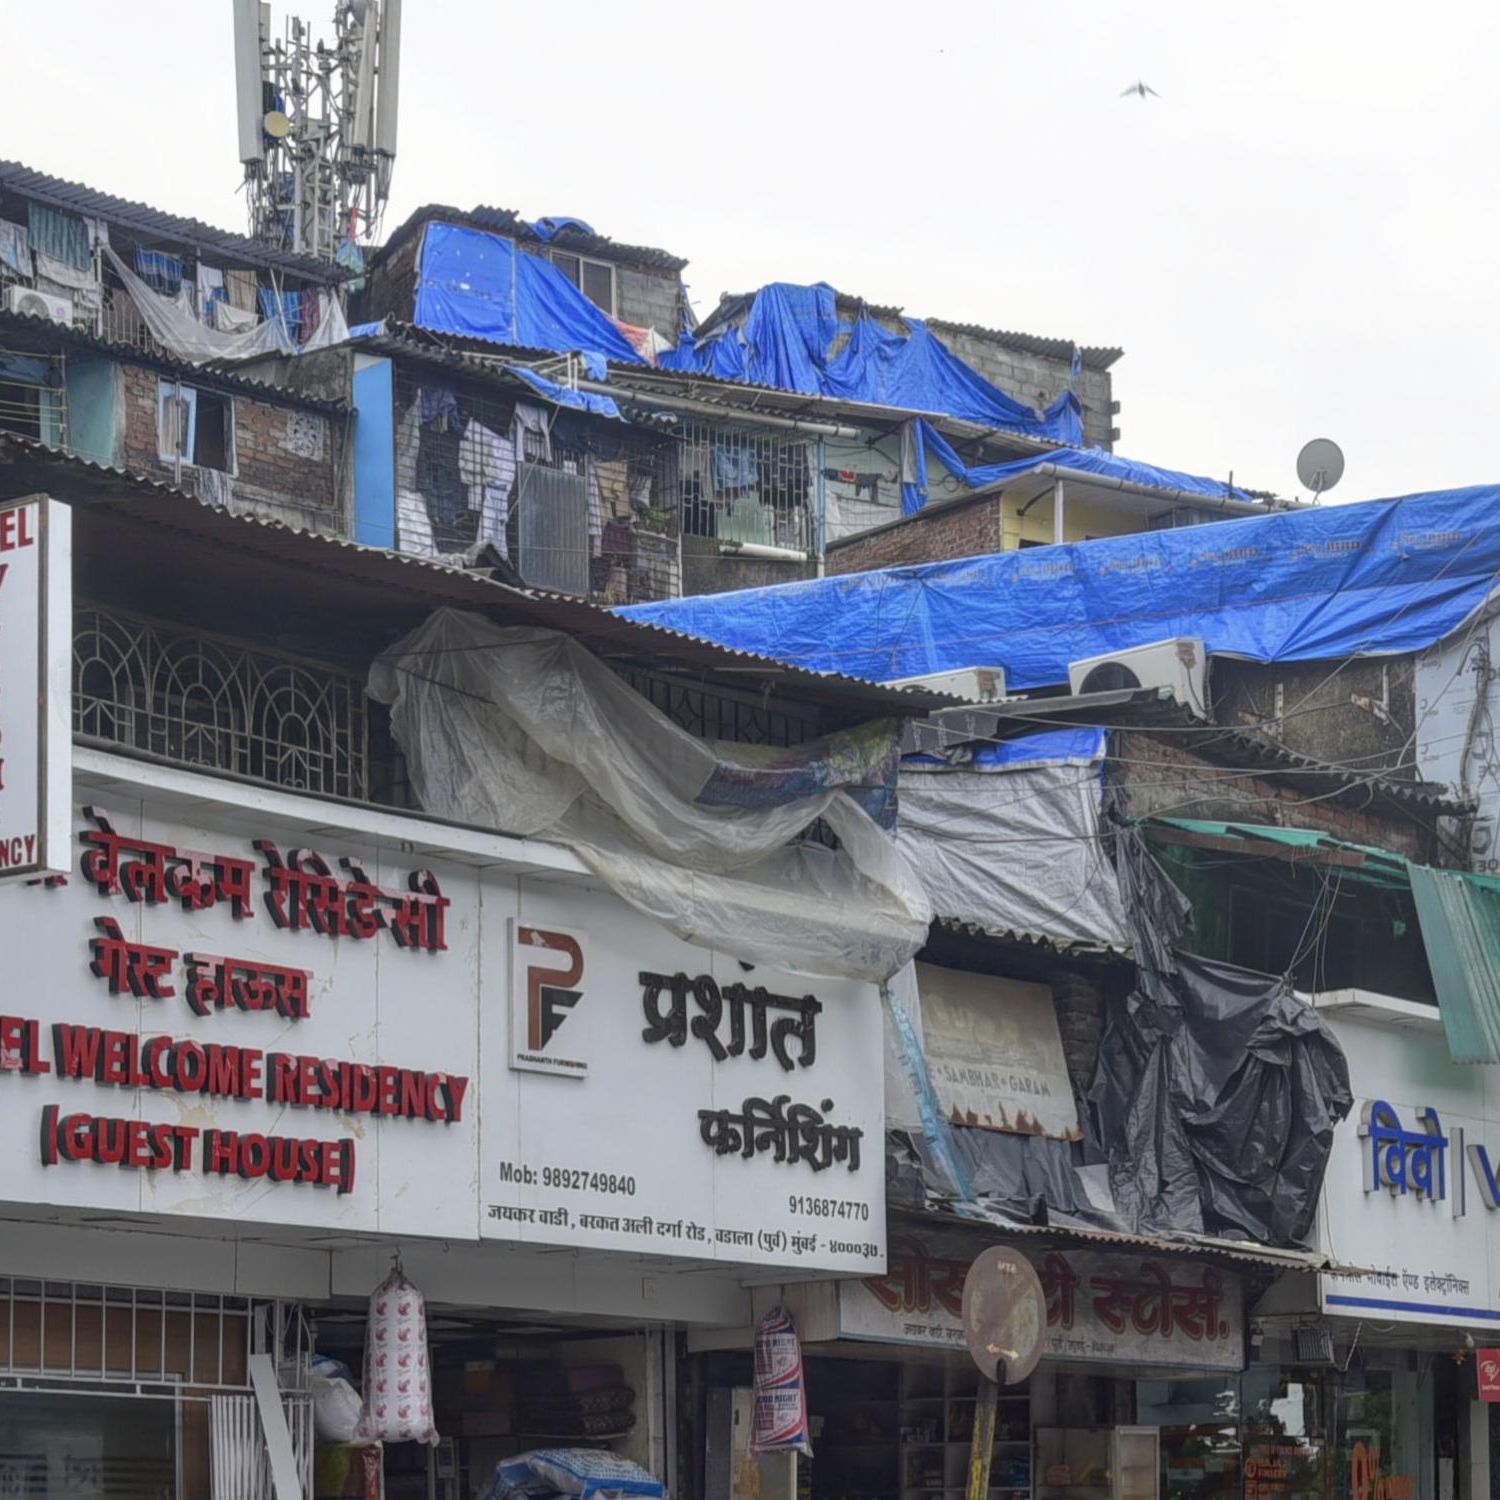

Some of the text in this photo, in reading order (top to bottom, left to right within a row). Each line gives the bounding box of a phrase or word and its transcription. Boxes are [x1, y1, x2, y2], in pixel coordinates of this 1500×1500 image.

[80, 805, 255, 920] वेलकम
[89, 916, 312, 1020] गेस्ट हाऊस
[639, 959, 822, 1071] प्रशांत
[52, 1022, 263, 1100] WELCOME
[266, 1051, 469, 1124] RESIDENCY
[1008, 1074, 1051, 1098] GARAM
[41, 1104, 355, 1195] (GUEST HOUSE)
[500, 1161, 636, 1196] Mob: 9892749840
[697, 1094, 863, 1172] फर्निशिंग
[1358, 1100, 1448, 1201] विवो
[488, 1203, 535, 1223] जयकर
[622, 1215, 653, 1236] अली
[715, 1227, 753, 1247] वडाला
[791, 1230, 818, 1255] मुंबई
[789, 1195, 869, 1222] 9136874770
